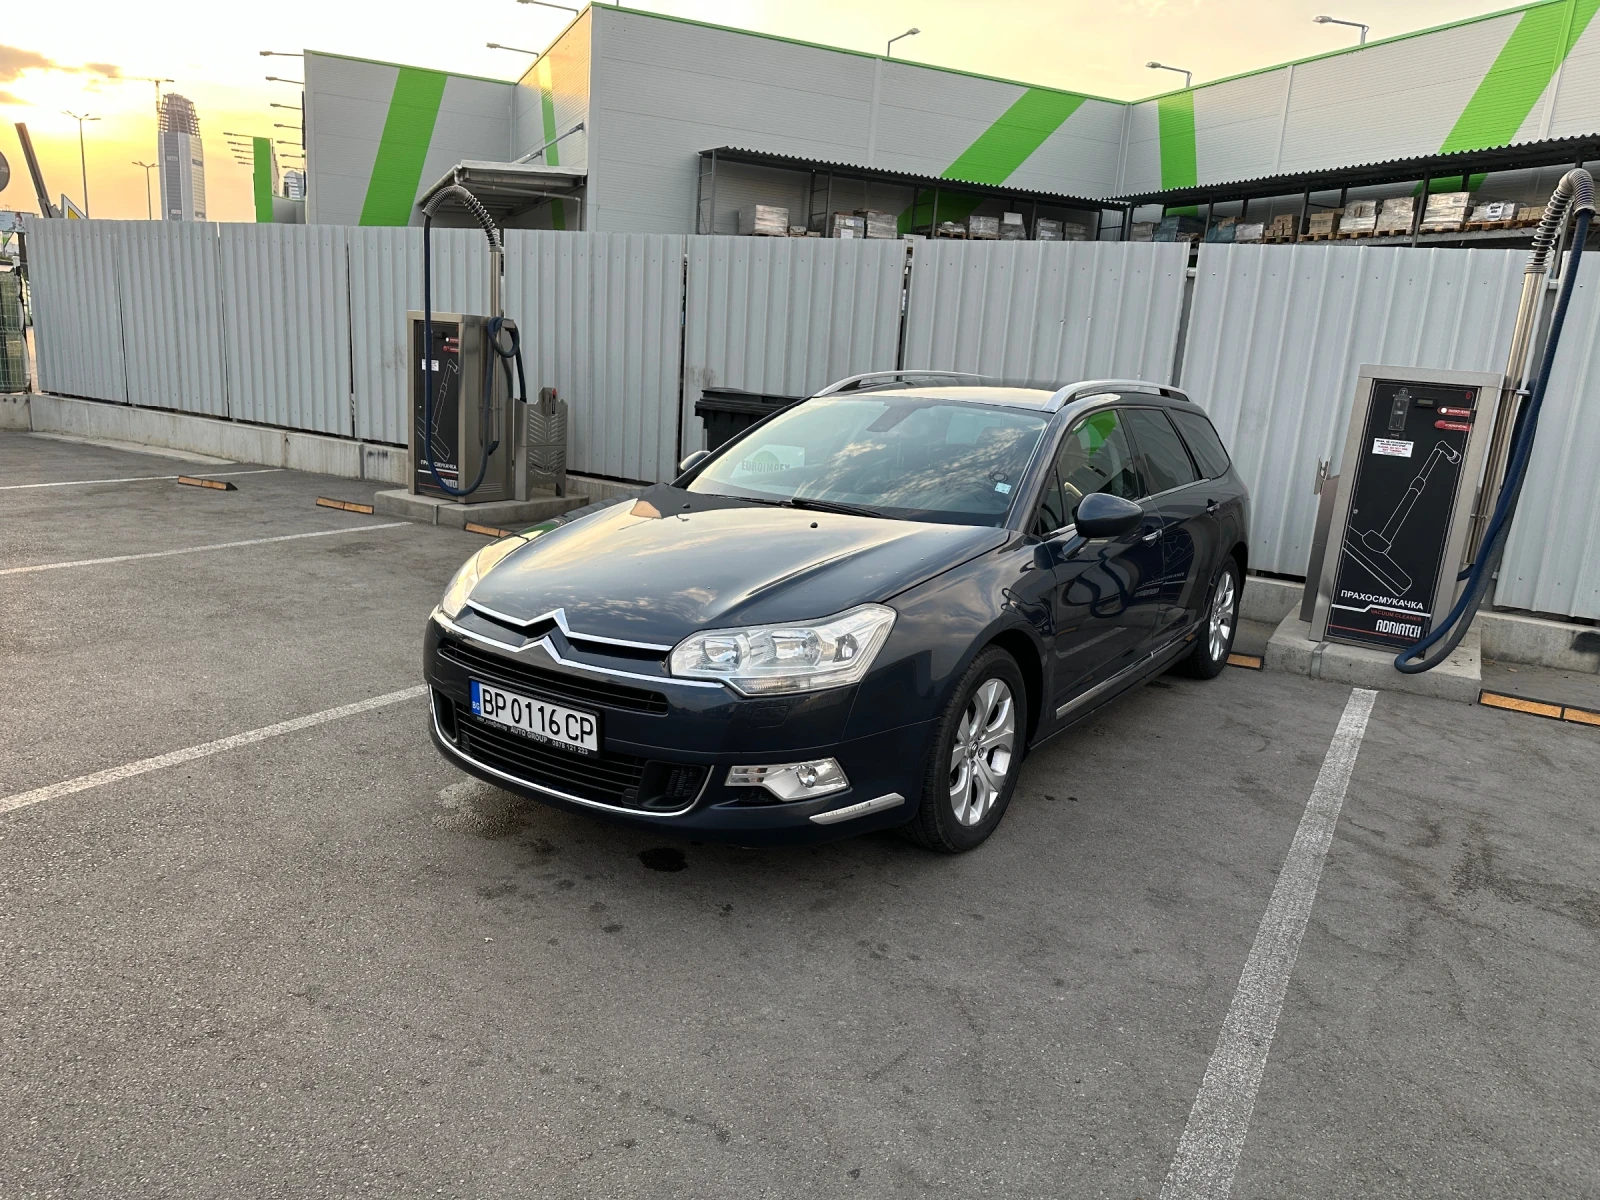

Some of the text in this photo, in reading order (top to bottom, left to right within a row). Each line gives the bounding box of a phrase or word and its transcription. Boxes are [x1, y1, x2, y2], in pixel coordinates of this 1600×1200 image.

[1340, 590, 1424, 610] ПРАХОСМУКАЧКА
[1395, 613, 1422, 622] CLEANER
[511, 698, 560, 735] 0116
[510, 726, 526, 736] AUTO
[527, 732, 548, 743] GROUP
